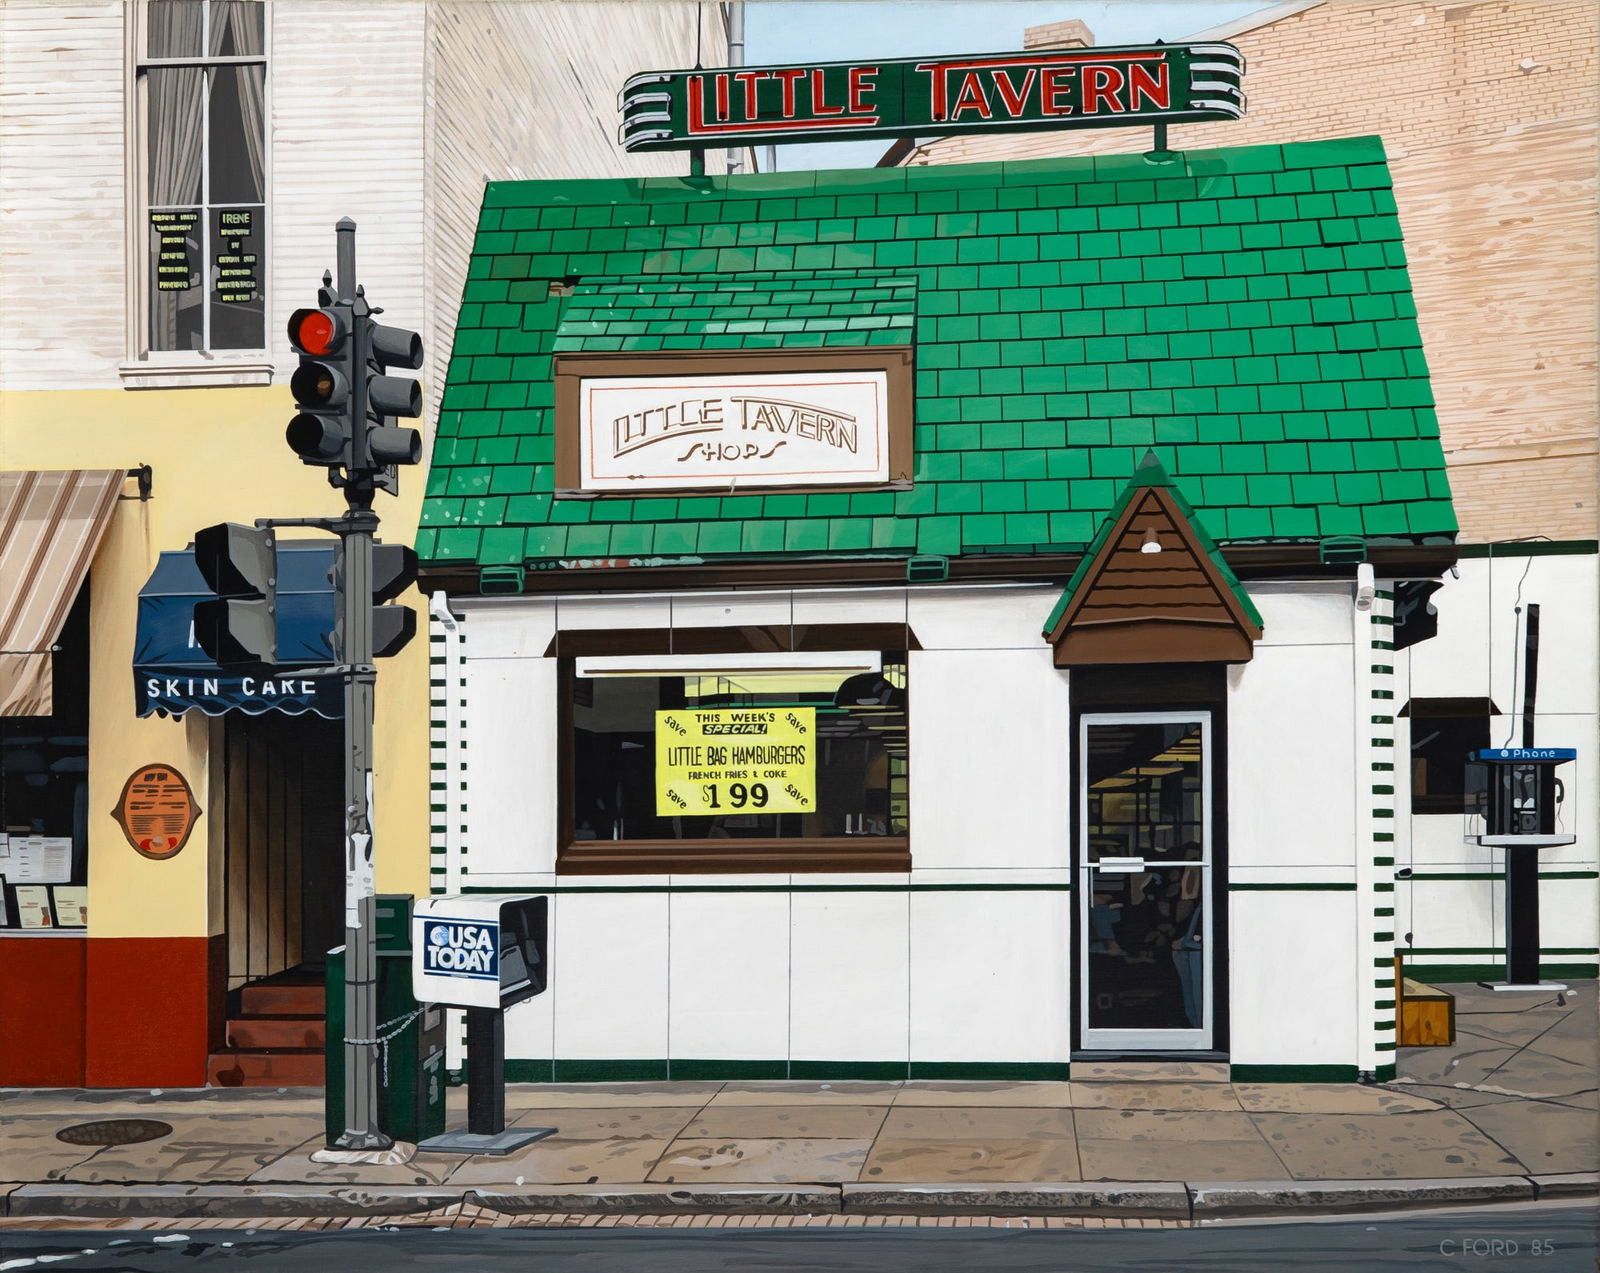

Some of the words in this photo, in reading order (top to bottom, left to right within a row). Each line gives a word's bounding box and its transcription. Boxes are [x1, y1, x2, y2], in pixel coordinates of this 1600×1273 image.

[687, 66, 880, 135] LITTLE
[915, 51, 1171, 123] TAVERN
[222, 213, 250, 224] IRENE
[613, 398, 723, 458] LITTLE
[730, 396, 857, 453] TAVERN
[677, 441, 787, 462] SHOPS
[147, 678, 218, 698] SKIN
[664, 715, 687, 736] save
[695, 713, 721, 723] THIS
[731, 712, 775, 723] WEEK'S
[785, 712, 806, 734] save
[704, 724, 767, 734] SPECIAL!
[668, 746, 702, 766] LITTLE
[707, 746, 727, 765] BAG
[732, 745, 805, 765] HAMBURGERS
[1513, 749, 1556, 758] Phone
[688, 771, 721, 780] FRENCH
[725, 770, 748, 778] FRIES
[764, 770, 787, 778] COKE
[666, 789, 687, 809] save
[785, 784, 808, 806] save
[448, 926, 494, 950] USA
[427, 945, 494, 972] TODAY
[1439, 1239, 1456, 1257] C
[1462, 1238, 1519, 1256] FORD
[1530, 1238, 1556, 1256] 85
